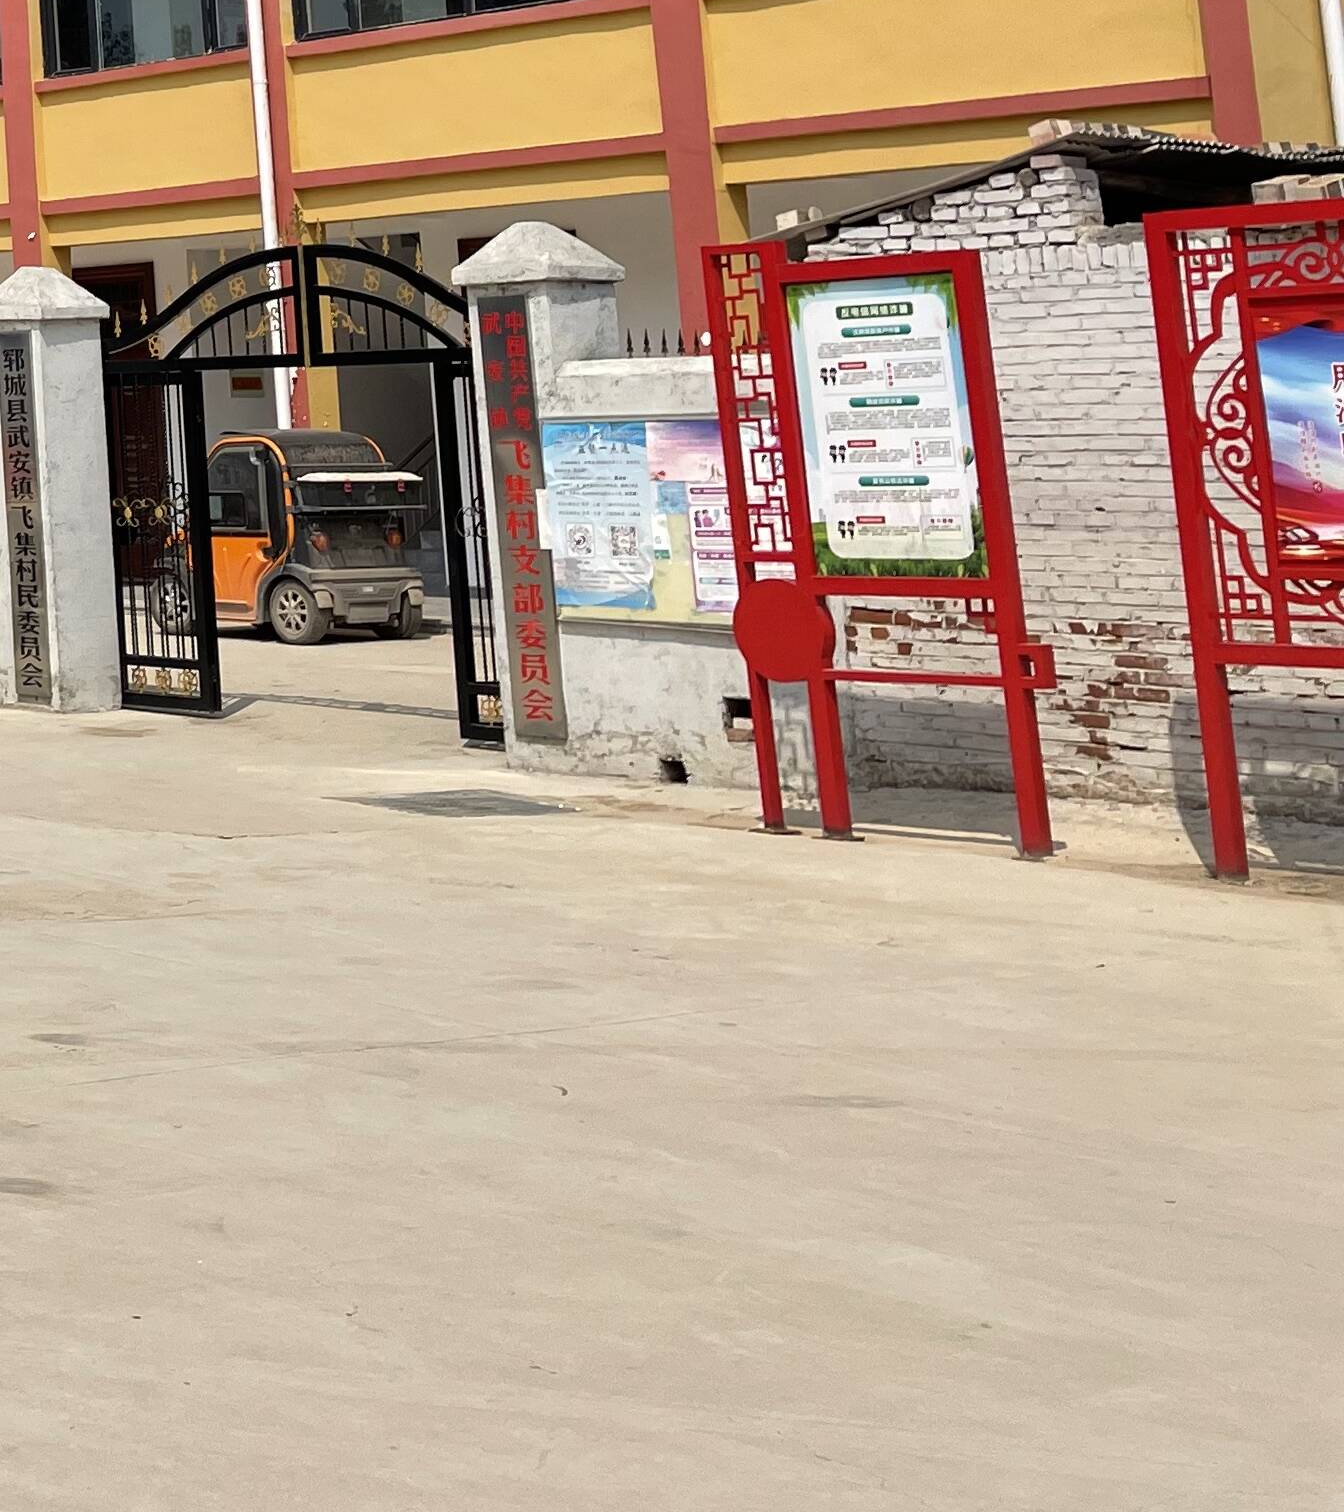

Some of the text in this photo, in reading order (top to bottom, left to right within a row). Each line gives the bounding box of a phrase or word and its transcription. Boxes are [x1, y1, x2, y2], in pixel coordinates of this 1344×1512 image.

[3, 347, 43, 689] 郓城县武安镇飞集村民委员会
[498, 440, 554, 722] 飞集村支部委员会
